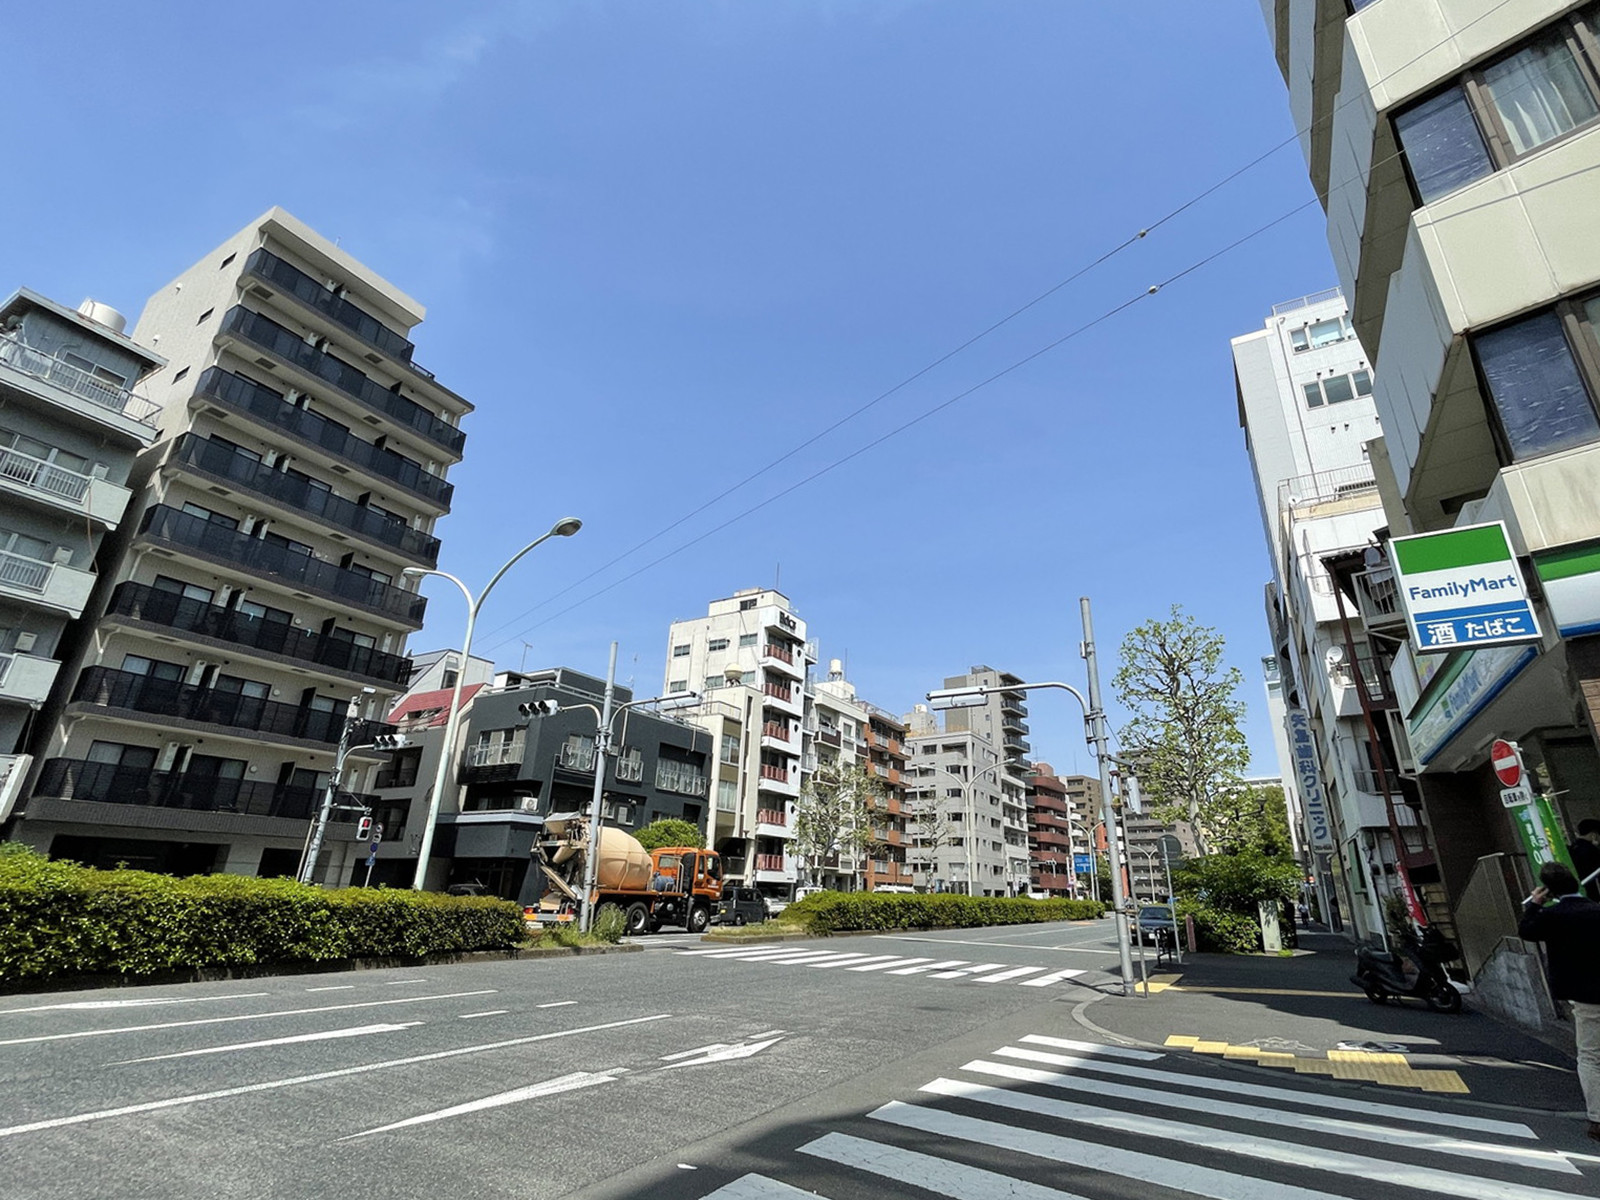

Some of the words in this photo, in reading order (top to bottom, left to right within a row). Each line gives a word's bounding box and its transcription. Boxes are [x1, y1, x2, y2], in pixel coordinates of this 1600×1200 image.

[1409, 575, 1517, 600] FamilyMart
[1427, 622, 1457, 644] 酒
[1465, 617, 1526, 638] たばこ
